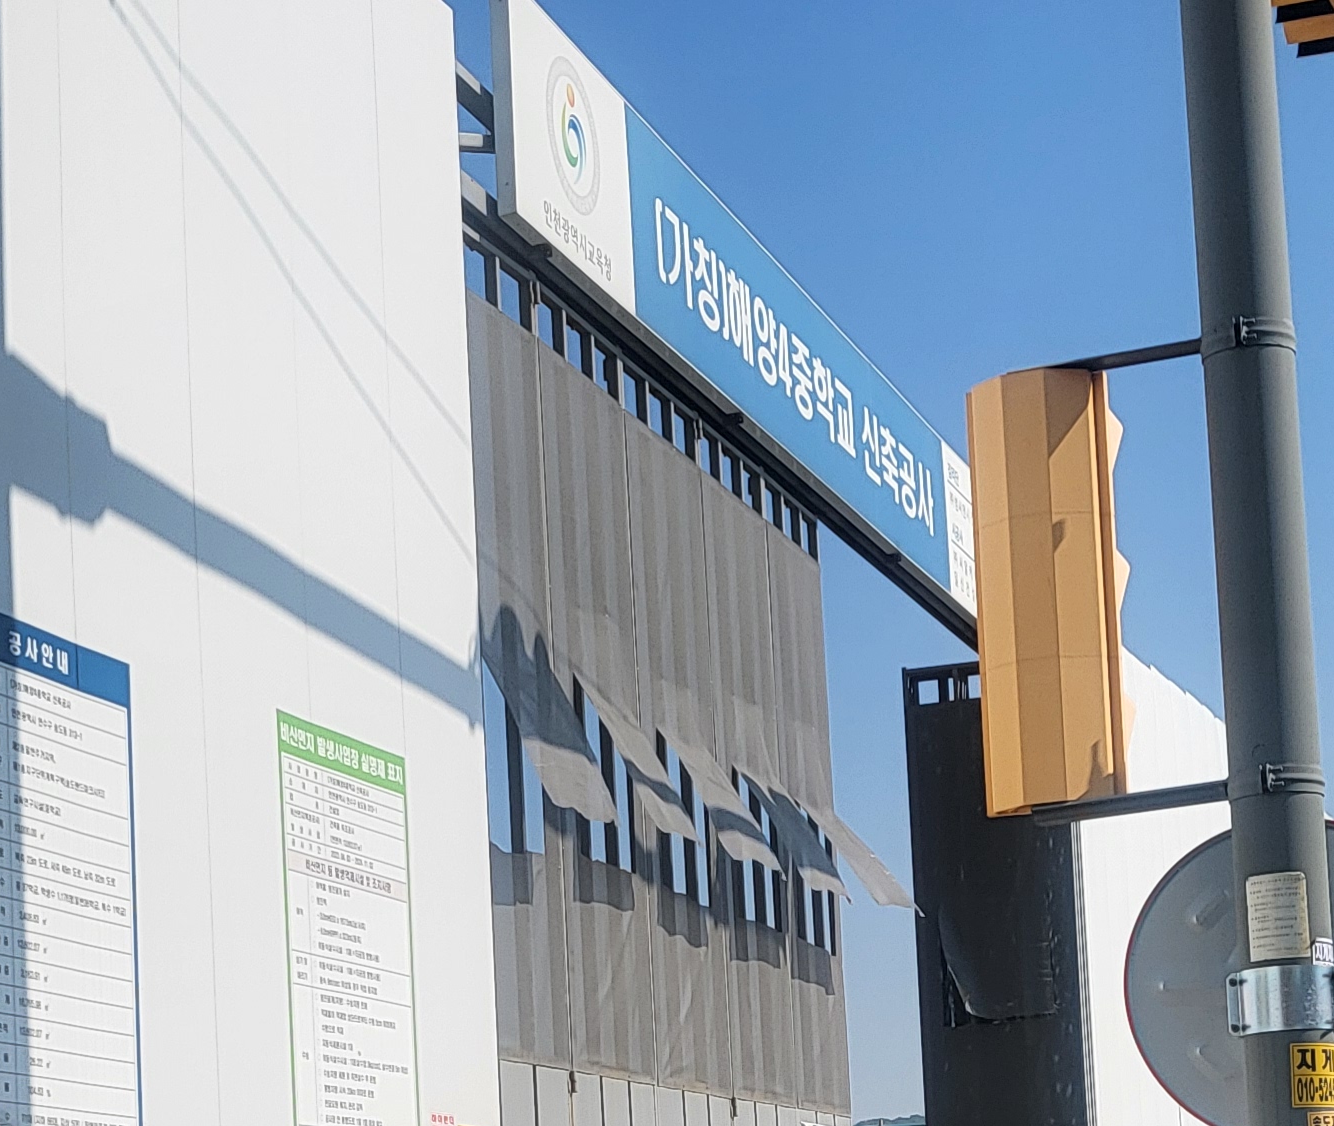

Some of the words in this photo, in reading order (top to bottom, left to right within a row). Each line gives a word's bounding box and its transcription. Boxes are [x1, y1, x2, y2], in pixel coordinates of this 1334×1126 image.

[543, 200, 612, 281] 인천광역시교육청
[655, 197, 857, 459] (가칭)해양4중학교
[862, 406, 934, 537] 신축공사
[8, 630, 69, 676] 공사안내
[280, 721, 315, 754] 비산먼지
[316, 735, 359, 770] 발생사업장
[361, 752, 386, 780] 실명제
[387, 762, 404, 785] 표지
